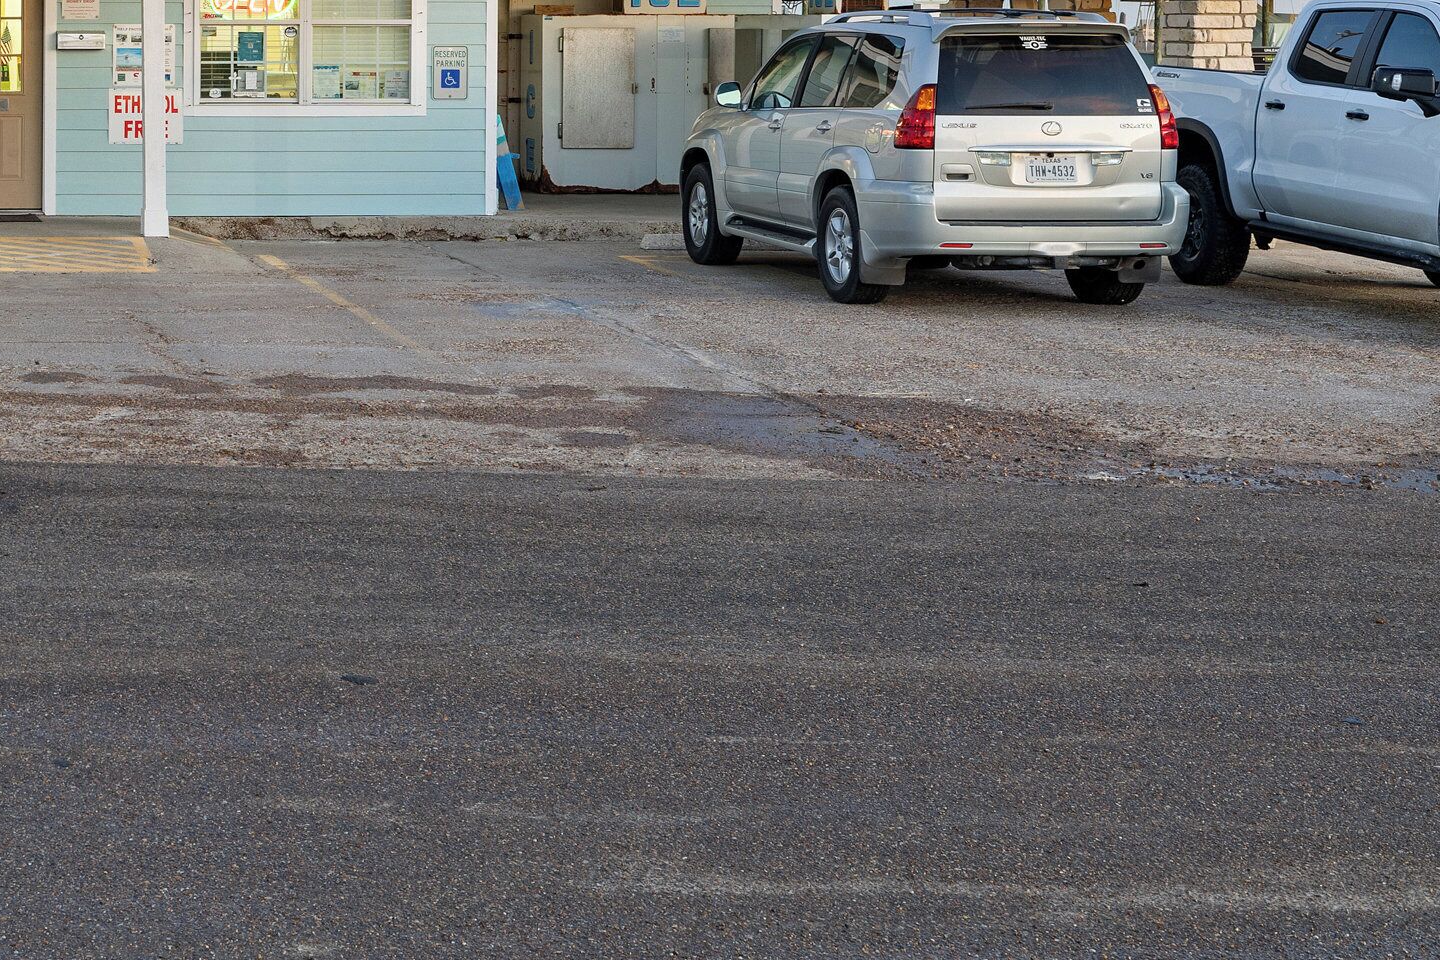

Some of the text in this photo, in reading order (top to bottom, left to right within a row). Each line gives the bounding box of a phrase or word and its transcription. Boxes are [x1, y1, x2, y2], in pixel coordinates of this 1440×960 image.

[436, 60, 465, 68] PARKING
[114, 95, 179, 114] ETHOL
[124, 120, 169, 138] FR
